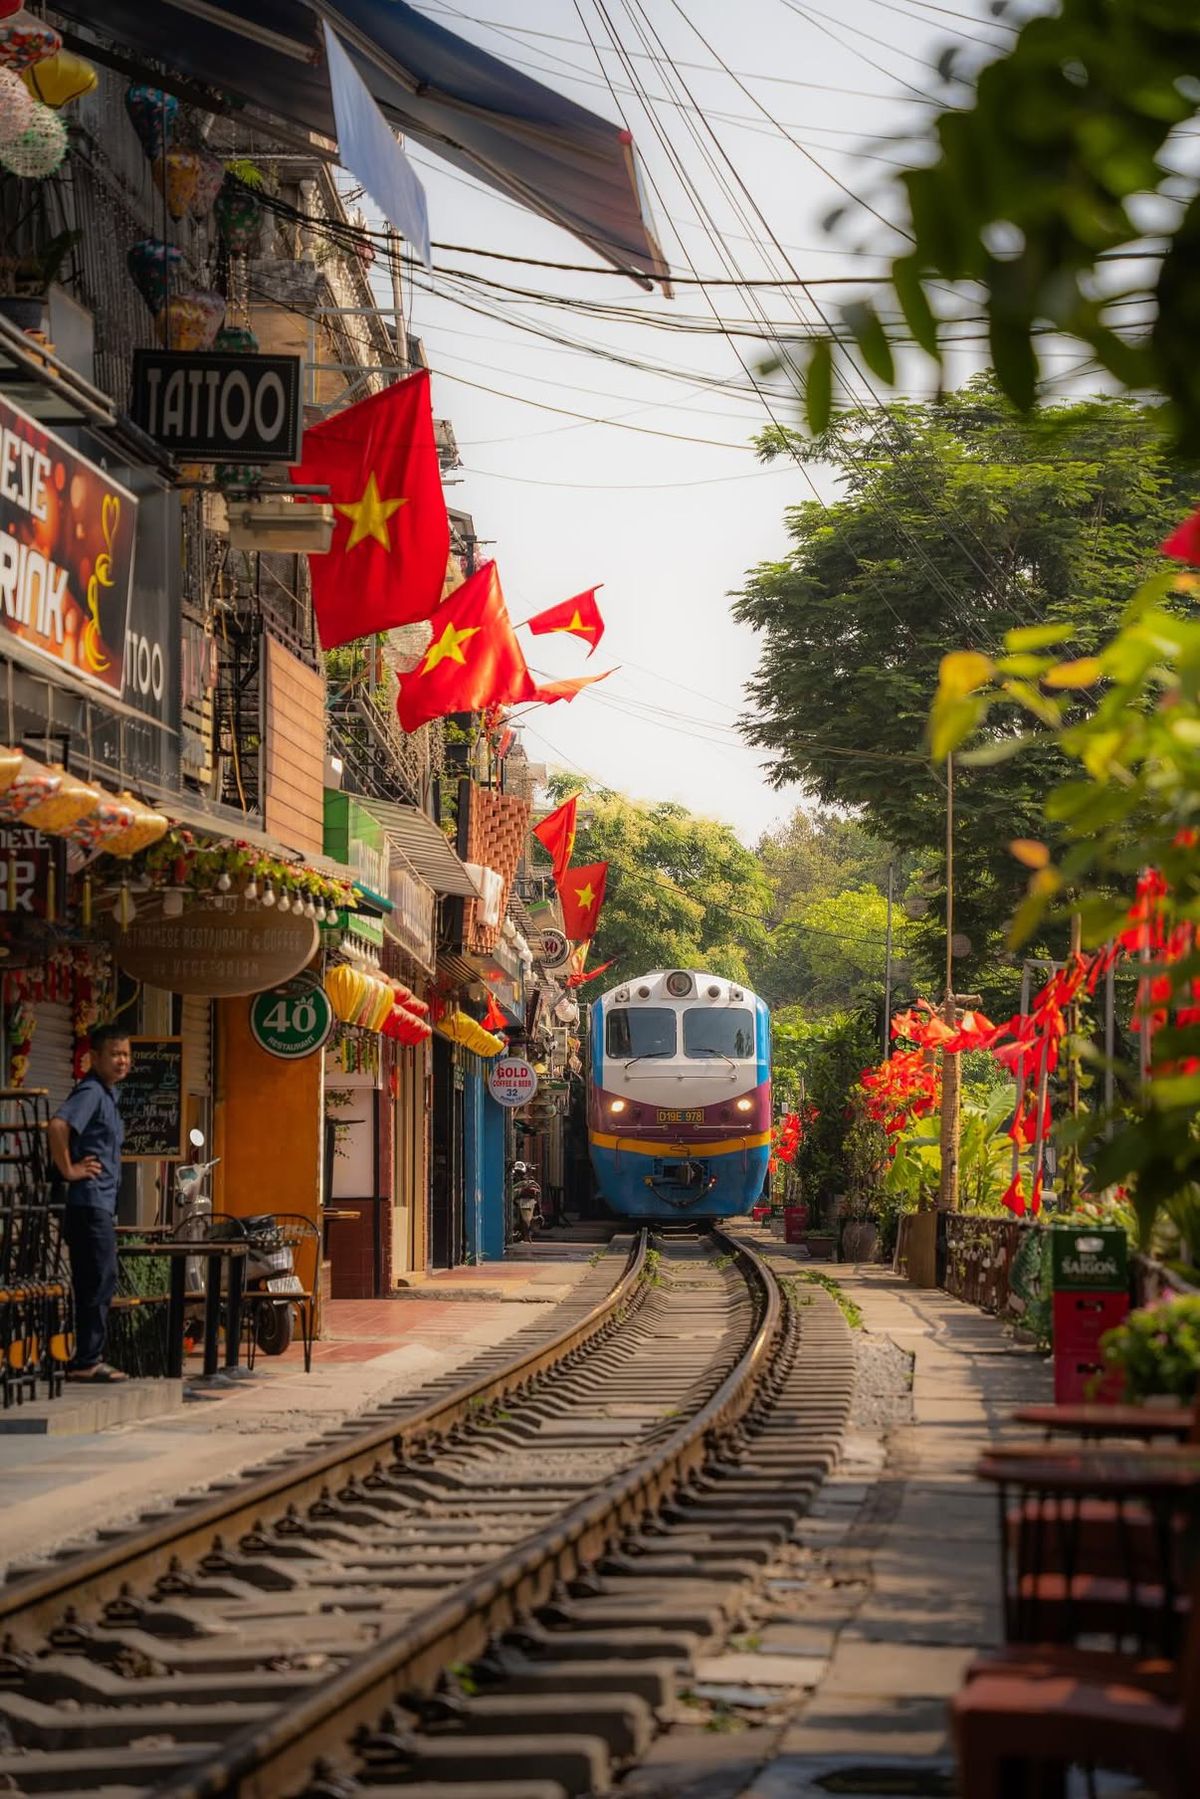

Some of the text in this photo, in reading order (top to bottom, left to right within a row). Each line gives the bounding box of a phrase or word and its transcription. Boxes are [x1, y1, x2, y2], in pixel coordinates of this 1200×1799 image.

[147, 368, 285, 442] TATTOO
[0, 424, 52, 523] ESE
[182, 927, 249, 950] RESTAURANT
[266, 1034, 316, 1052] RESTAURANT
[496, 1067, 529, 1078] GOLD
[493, 1079, 512, 1088] COFFEE
[518, 1079, 532, 1088] BEER
[506, 1088, 518, 1097] 32
[1061, 1259, 1120, 1275] SAIGON
